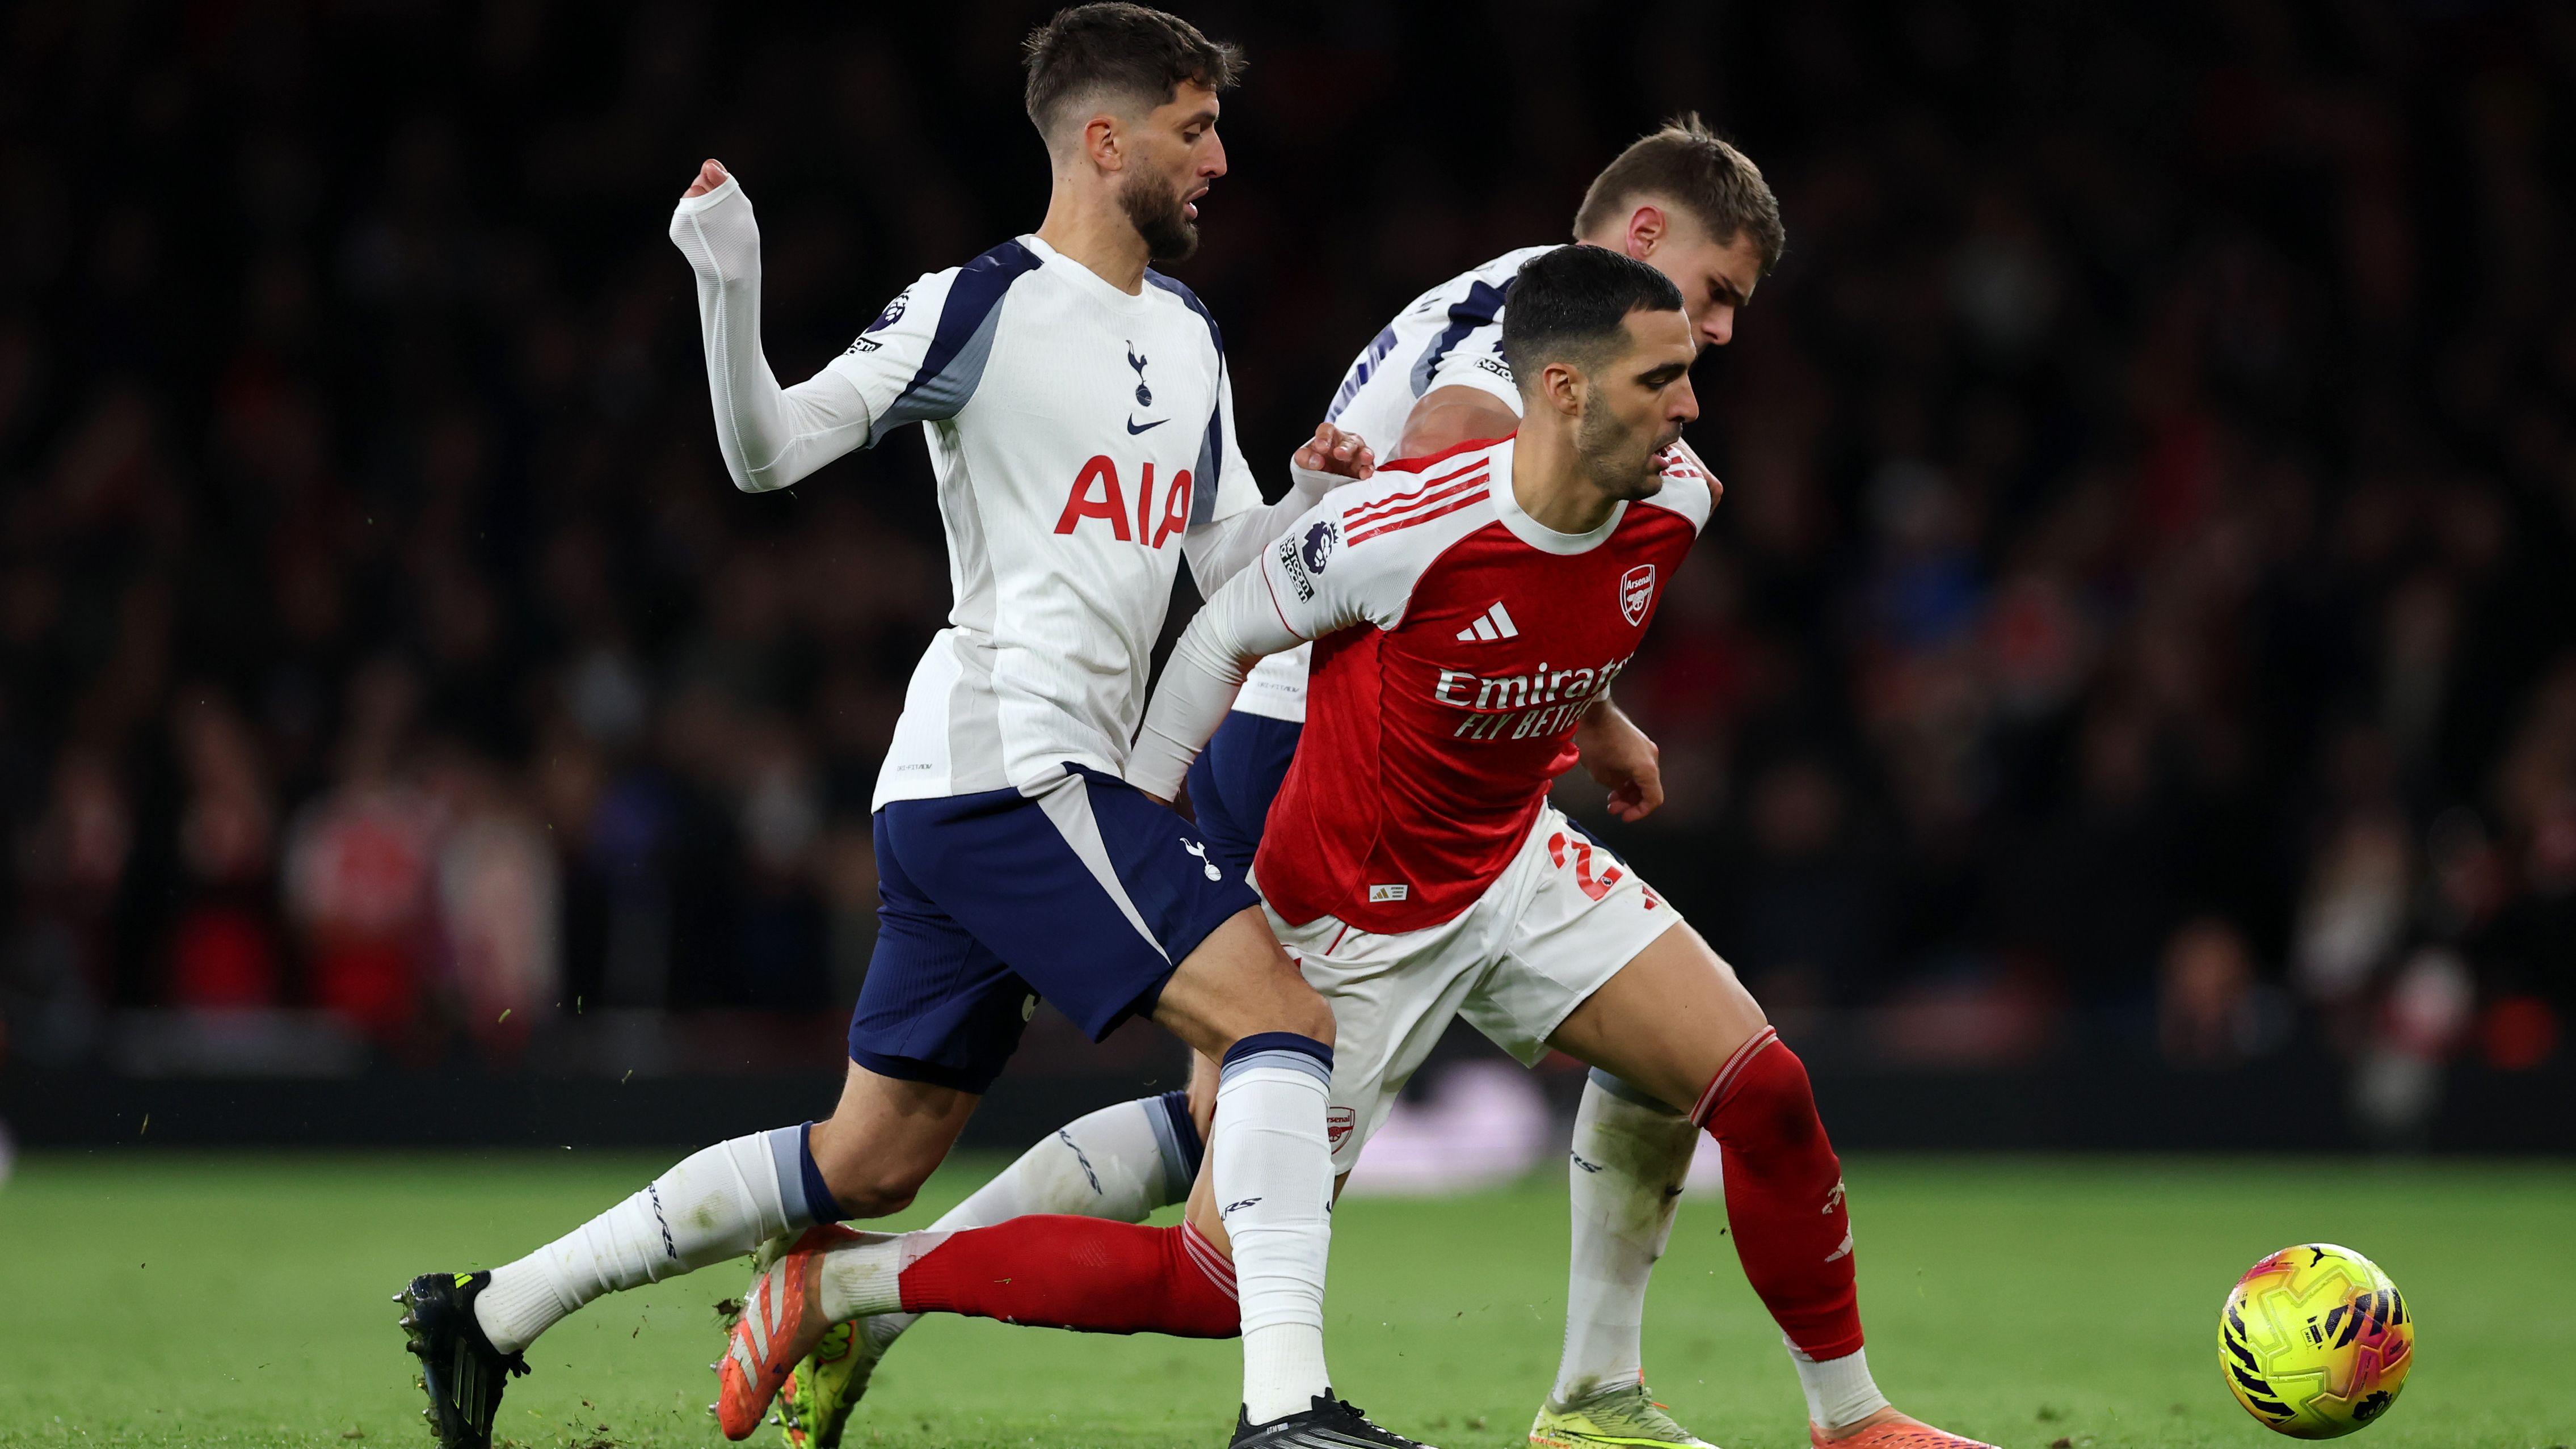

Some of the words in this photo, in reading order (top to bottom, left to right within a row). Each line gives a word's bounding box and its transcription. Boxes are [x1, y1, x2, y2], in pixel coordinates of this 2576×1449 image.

[1476, 357, 1498, 371] No
[1054, 454, 1192, 550] AIA
[1284, 559, 1309, 603] racism
[1285, 534, 1295, 555] No
[1290, 555, 1310, 592] room
[1626, 572, 1651, 590] Arsenal
[1435, 651, 1635, 710] Emirate
[1454, 713, 1516, 740] FLY
[1548, 832, 1624, 902] 2
[1327, 1115, 1350, 1123] rsenal
